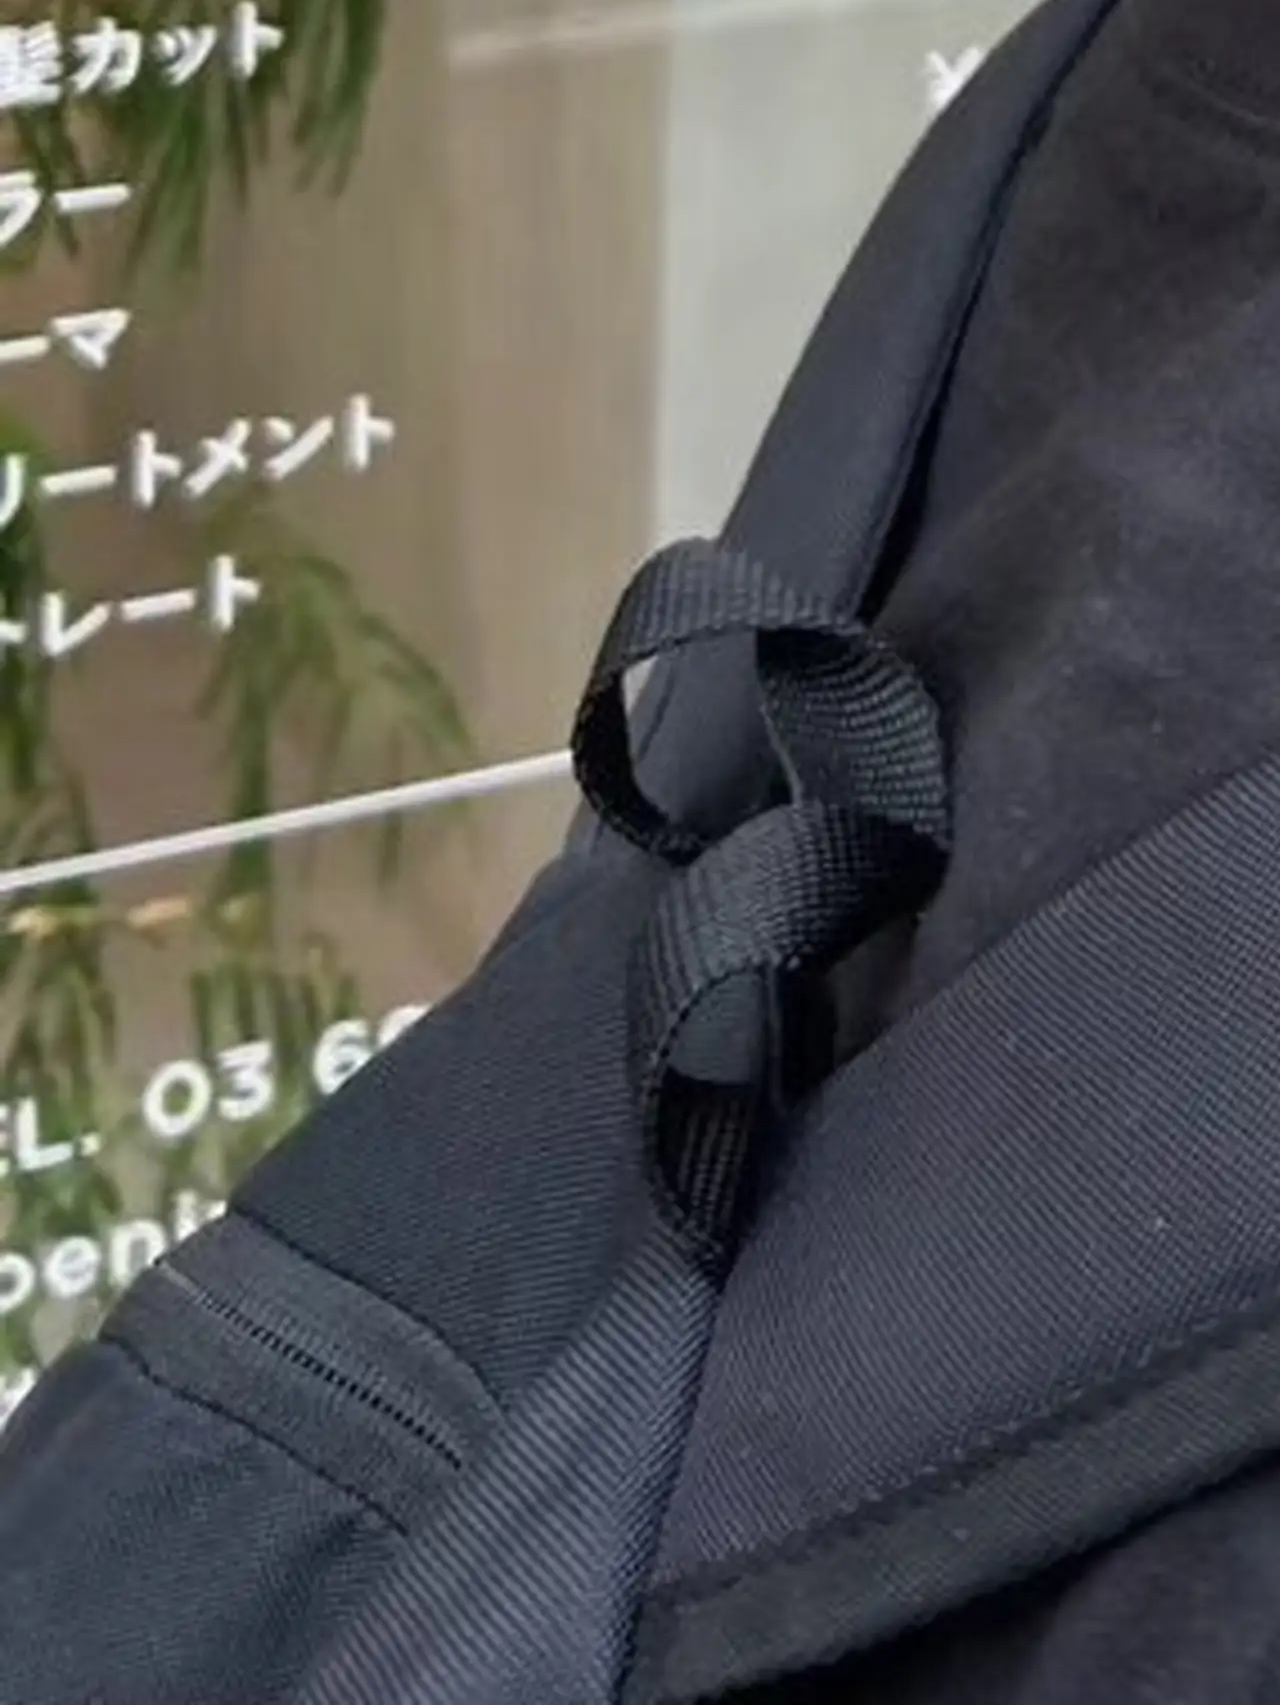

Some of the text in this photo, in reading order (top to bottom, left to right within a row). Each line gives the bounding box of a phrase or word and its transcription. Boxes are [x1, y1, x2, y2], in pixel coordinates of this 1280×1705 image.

[0, 1003, 432, 1177] L. 03 6
